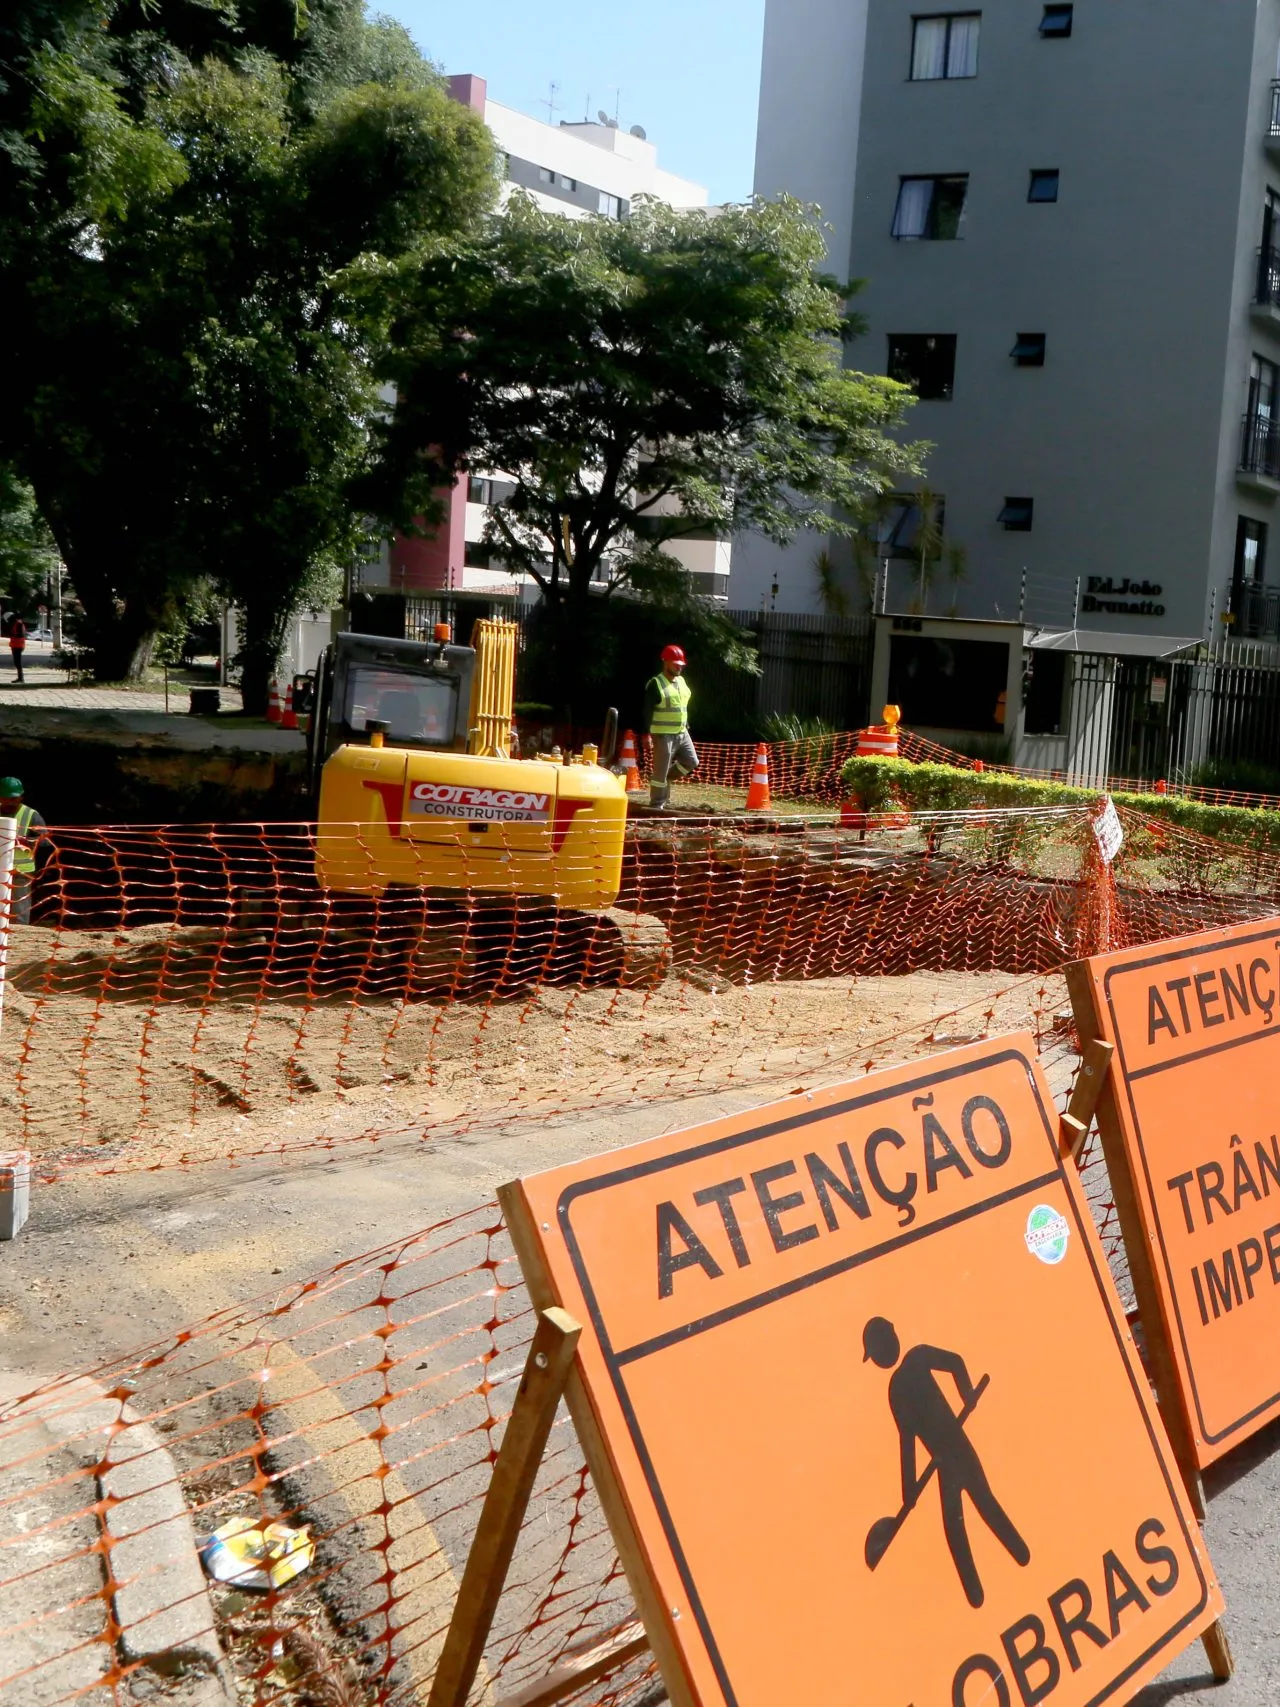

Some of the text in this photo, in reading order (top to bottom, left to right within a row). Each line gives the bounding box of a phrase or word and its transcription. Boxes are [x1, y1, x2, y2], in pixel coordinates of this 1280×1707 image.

[413, 783, 549, 810] COTRAGON
[424, 803, 533, 821] CONSTRUTORA
[657, 1093, 1012, 1299] ATENÇÃO
[952, 1518, 1179, 1707] OBRAS
